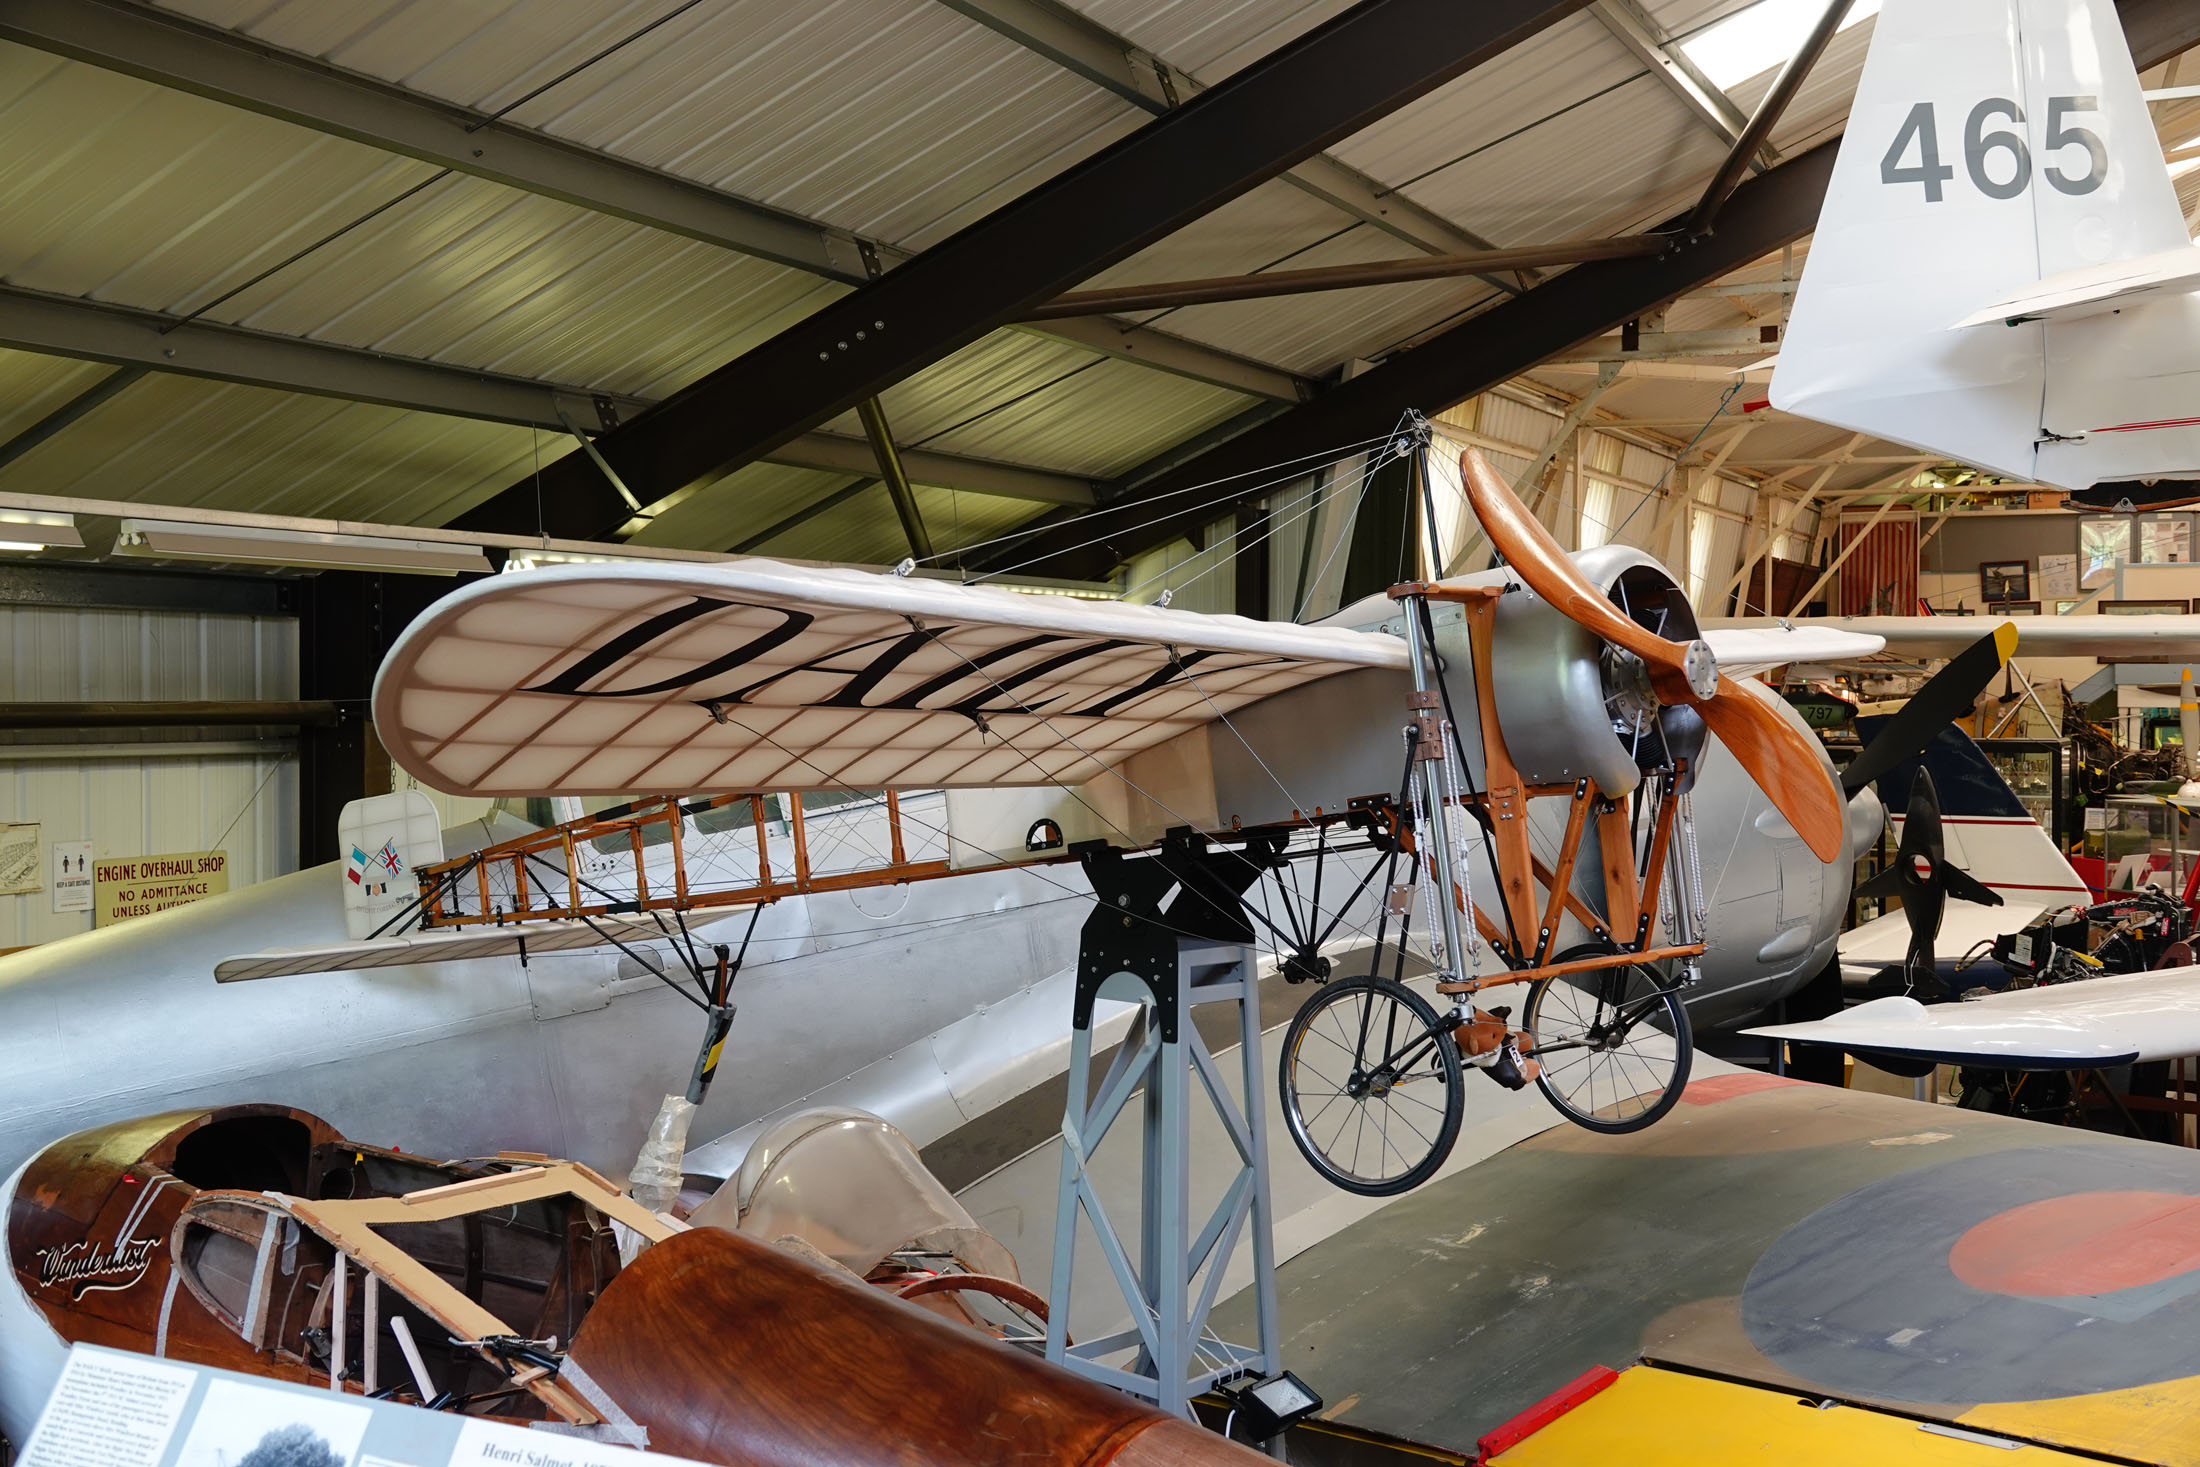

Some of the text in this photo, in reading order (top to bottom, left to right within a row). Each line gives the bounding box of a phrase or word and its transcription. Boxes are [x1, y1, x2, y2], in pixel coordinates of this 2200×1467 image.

[1880, 95, 2108, 203] 465
[515, 595, 1308, 718] DAILY
[1807, 706, 1833, 720] 797
[97, 856, 225, 883] ENGINE OVERHAUL SHOP
[118, 882, 208, 902] NO ADMITTANCE
[112, 903, 151, 918] UNLESS
[482, 1442, 524, 1464] Henri
